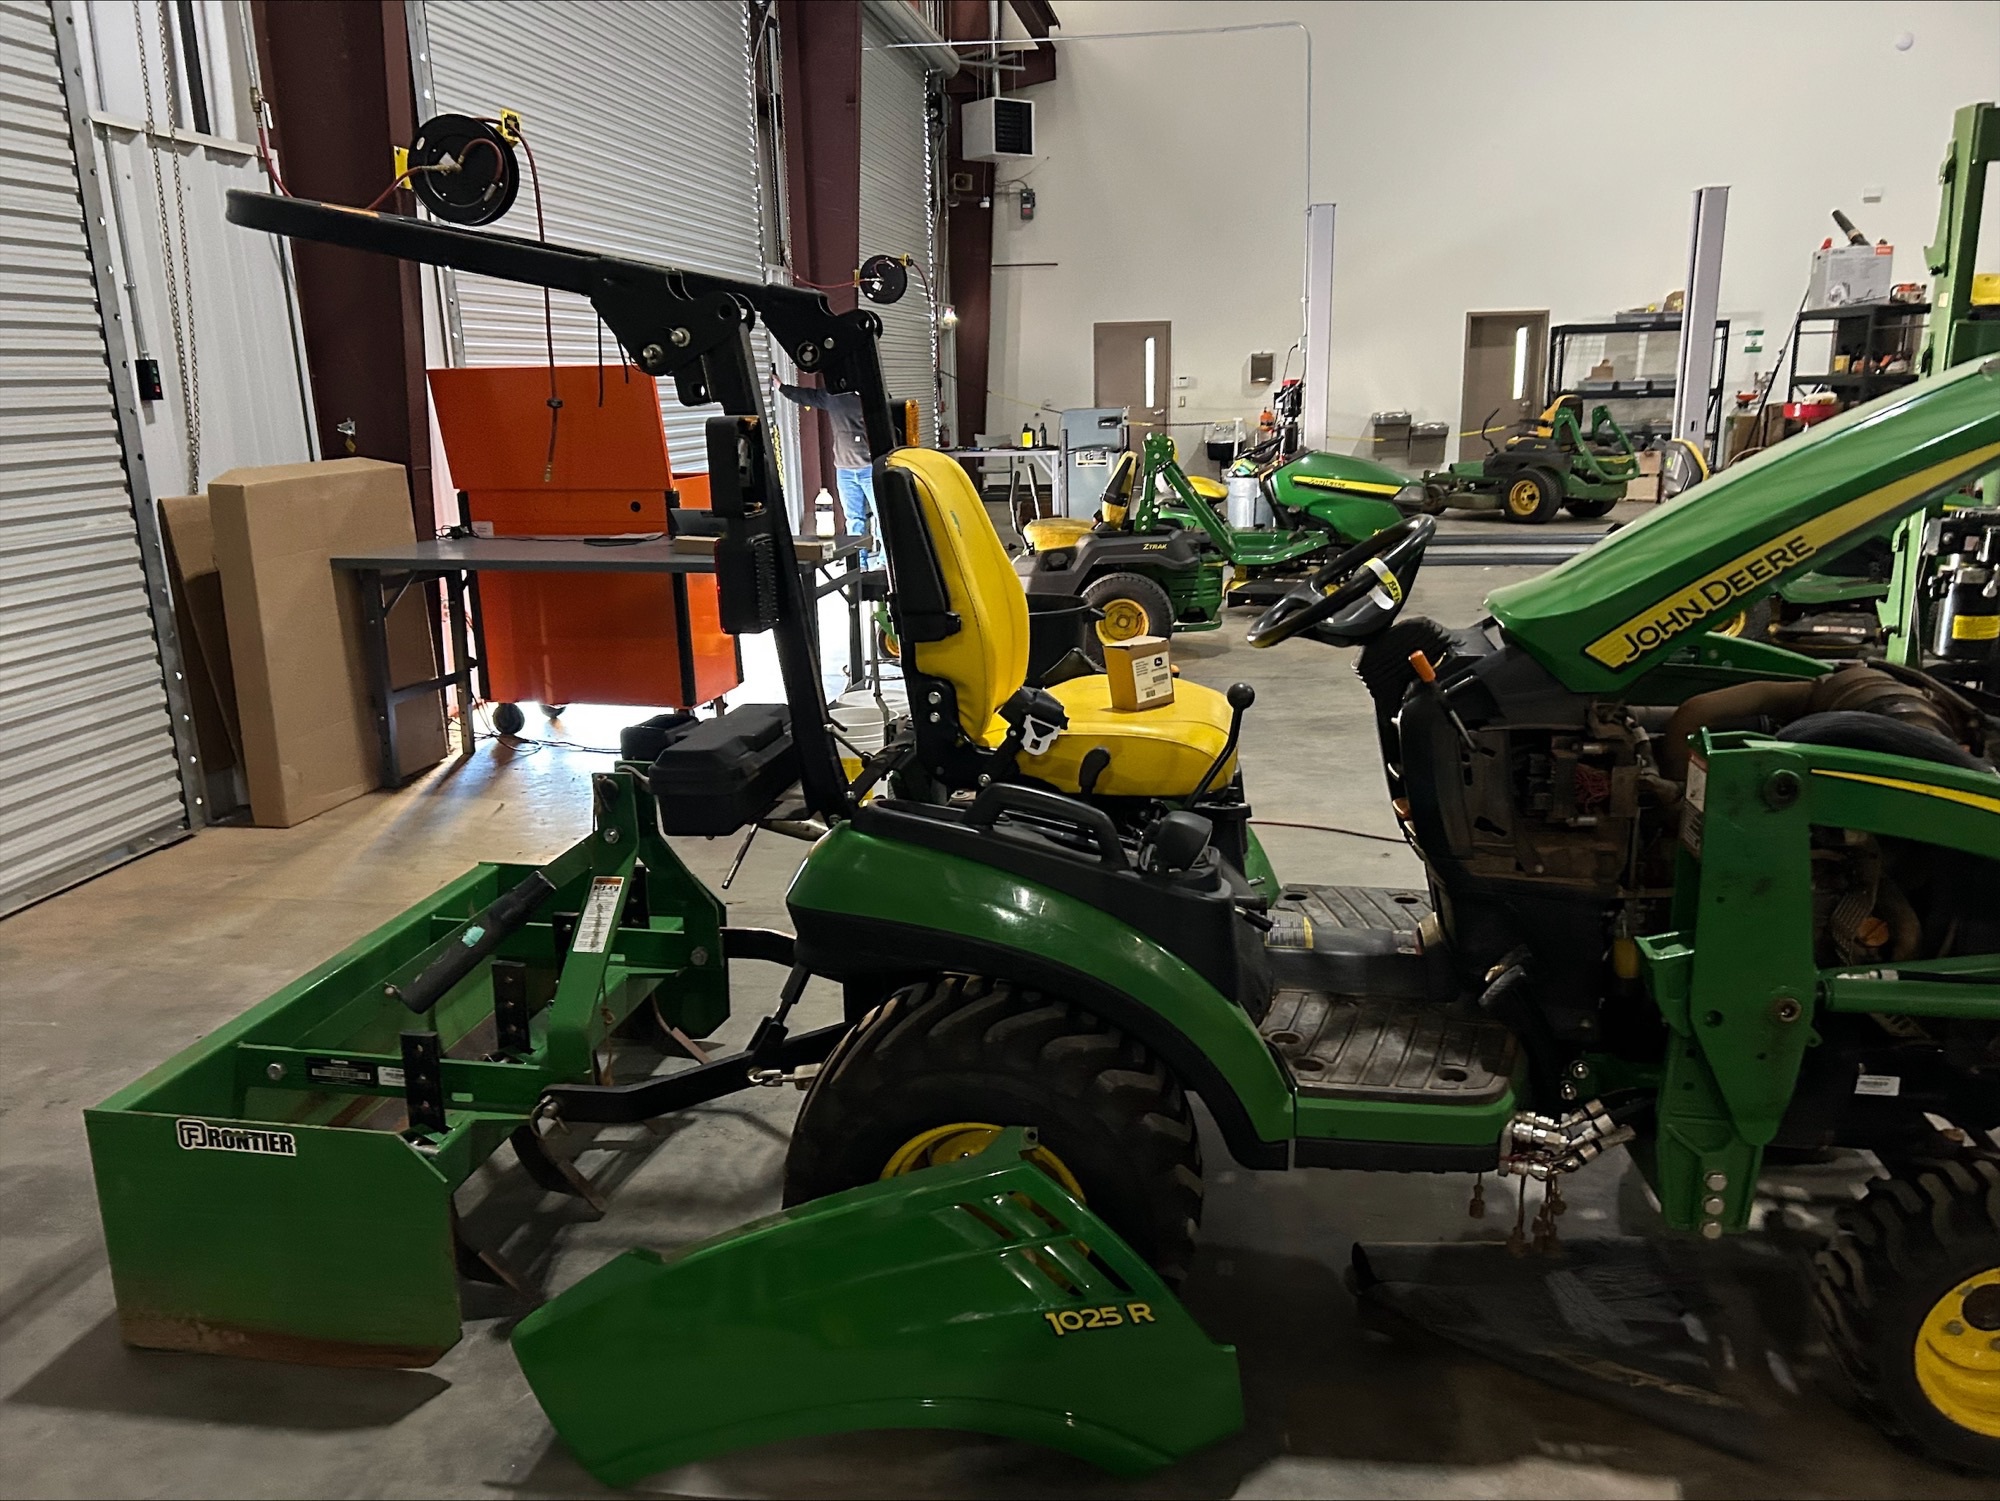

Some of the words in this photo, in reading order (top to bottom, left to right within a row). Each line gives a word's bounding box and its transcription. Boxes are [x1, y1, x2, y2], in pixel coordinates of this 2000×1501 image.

[1624, 599, 1704, 659] JOHN
[1700, 535, 1814, 606] DEERE
[178, 1120, 295, 1154] FRONTIER
[1044, 1306, 1123, 1335] 1025
[1126, 1303, 1155, 1324] R
